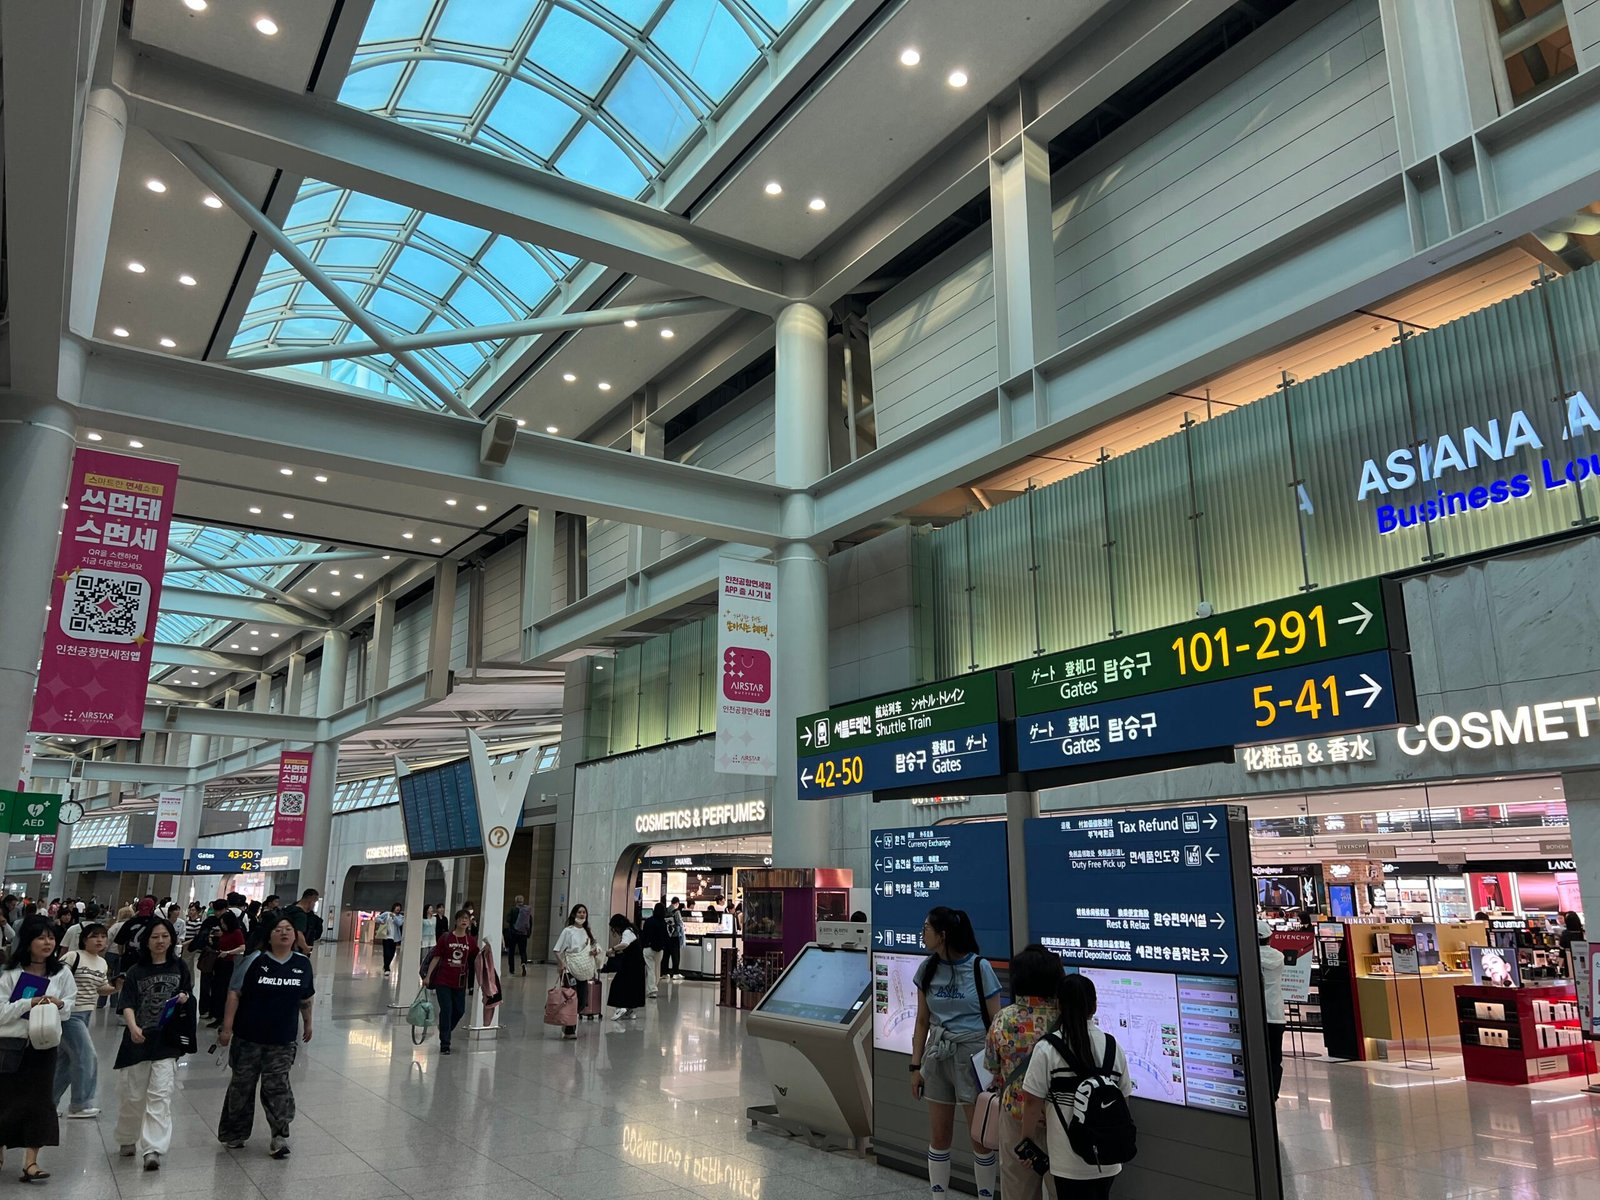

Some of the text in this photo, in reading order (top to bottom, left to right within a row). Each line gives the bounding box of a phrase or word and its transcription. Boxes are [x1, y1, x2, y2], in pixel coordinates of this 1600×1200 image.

[1358, 410, 1543, 501] ASIANA
[88, 476, 123, 487] 스마트한
[80, 489, 162, 521] 쓰면돼
[1376, 473, 1532, 535] Business
[75, 520, 158, 551] 스면세
[81, 557, 96, 565] 지금
[88, 549, 108, 558] QR을
[725, 586, 738, 595] APP
[1171, 604, 1328, 676] 101-291
[56, 644, 141, 662] 인천공항면세점앱
[1031, 651, 1152, 684] ゲート 登机口 탑승구
[730, 682, 764, 692] AIRSTAR
[1060, 680, 1098, 699] Gates
[1253, 674, 1341, 728] 5-41
[78, 712, 114, 720] AIRSTAR
[834, 715, 872, 739] 셔틀트레인
[876, 714, 932, 738] Shuttle Train
[1029, 712, 1158, 743] ゲート 登机口 탑승구
[1397, 696, 1600, 756] COSMET
[932, 733, 988, 756] 登机口 ゲート
[1062, 737, 1101, 756] Gates
[1244, 734, 1373, 772] 化粧品 & 香水
[896, 750, 927, 774] 탑승구
[932, 758, 962, 774] Gates
[814, 755, 864, 789] 42-50
[22, 818, 45, 827] AED
[635, 800, 766, 834] COSMETICS & PERFUMES
[1118, 821, 1136, 833] Tax
[1138, 816, 1179, 832] Refund
[908, 840, 951, 848] Currency Exchange
[228, 850, 254, 859] 43-50
[1130, 850, 1180, 864] 면세품인도장
[240, 862, 252, 870] 42
[912, 864, 934, 874] Smoking
[1072, 860, 1126, 870] Duty Free Pick up
[914, 890, 930, 898] Toilets
[1106, 920, 1150, 930] Rest & Relax
[1154, 912, 1208, 928] 환승편의시설
[896, 934, 917, 944] 푸드코트
[1062, 950, 1077, 958] Point
[1077, 950, 1084, 958] of
[1084, 950, 1112, 960] Deposited
[1113, 952, 1132, 961] Goods
[258, 976, 301, 986] WORLD WIDE
